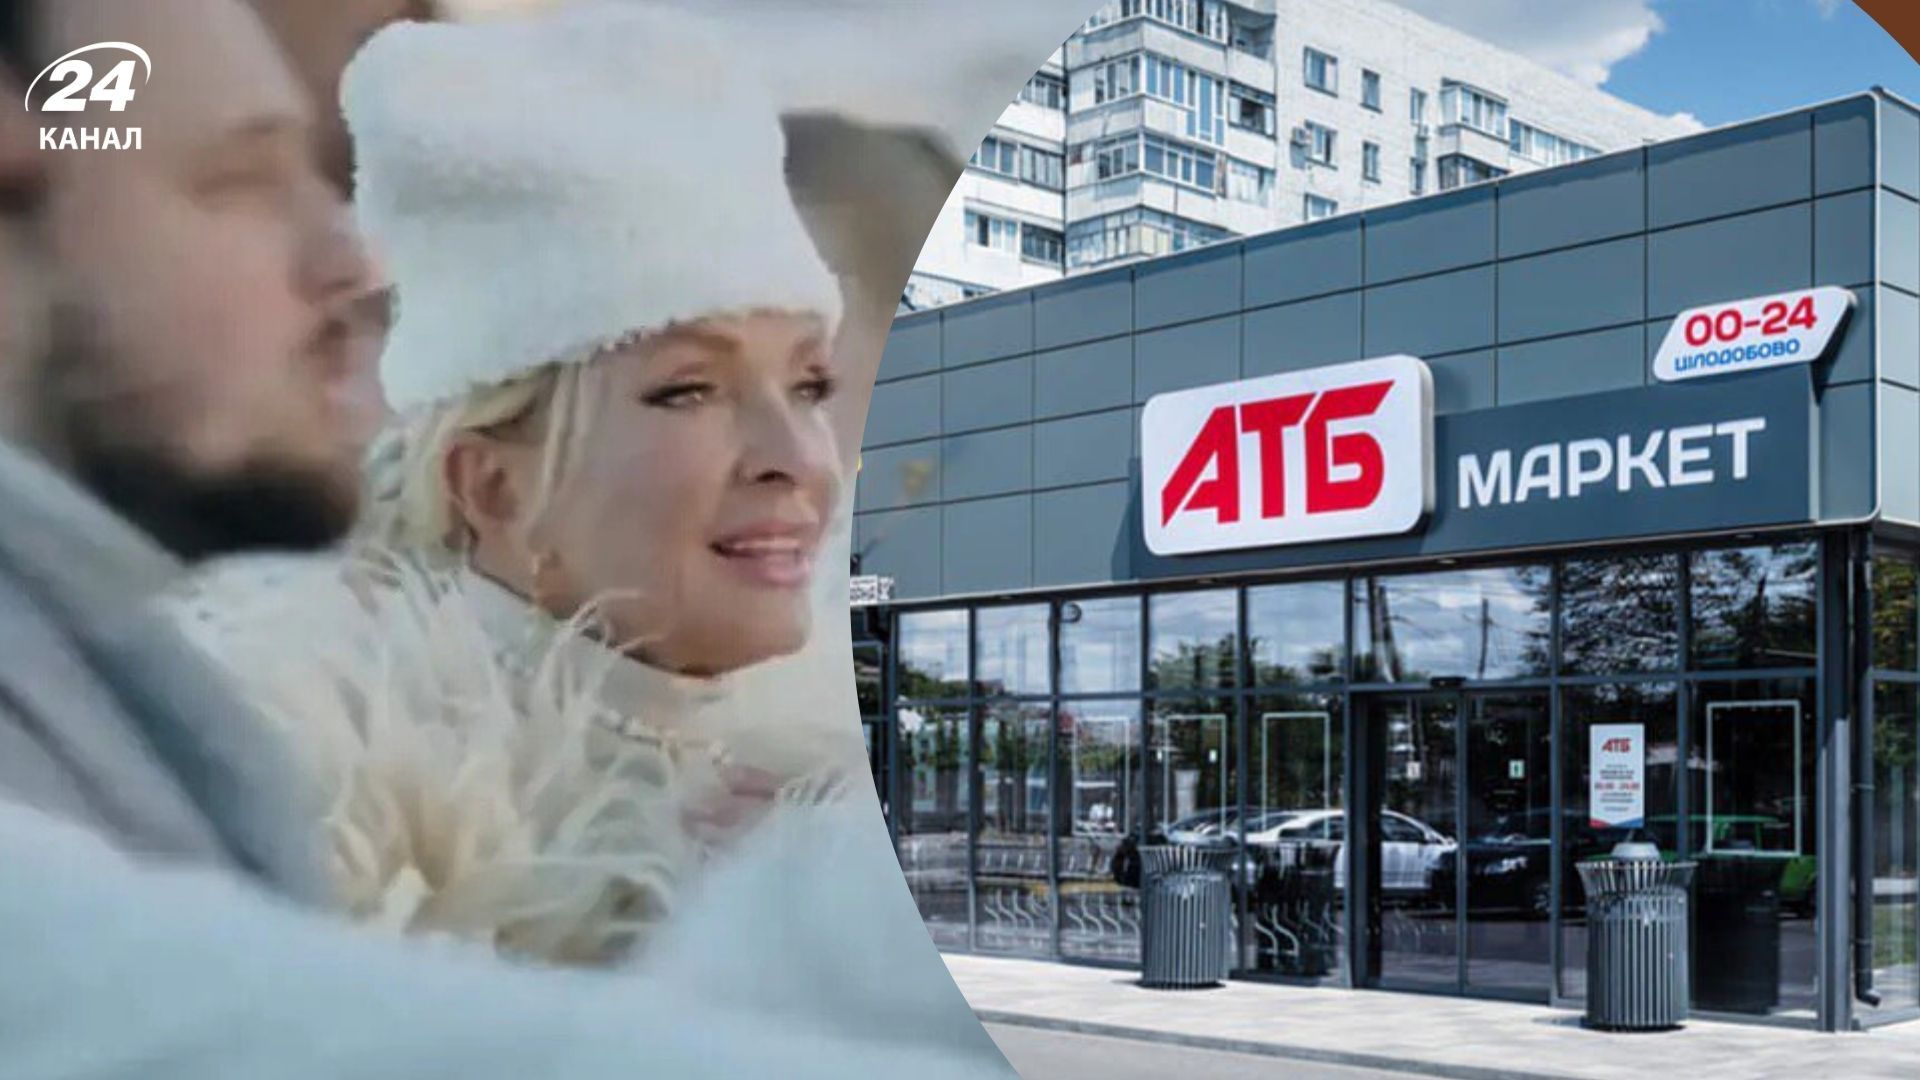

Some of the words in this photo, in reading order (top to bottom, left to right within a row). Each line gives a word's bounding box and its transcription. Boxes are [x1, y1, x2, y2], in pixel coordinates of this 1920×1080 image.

[1673, 338, 1801, 373] ЦІЛОДОБОВО
[1684, 296, 1817, 347] 00-24
[1160, 380, 1395, 530] АТБ
[1457, 416, 1766, 510] МАРКЕТ
